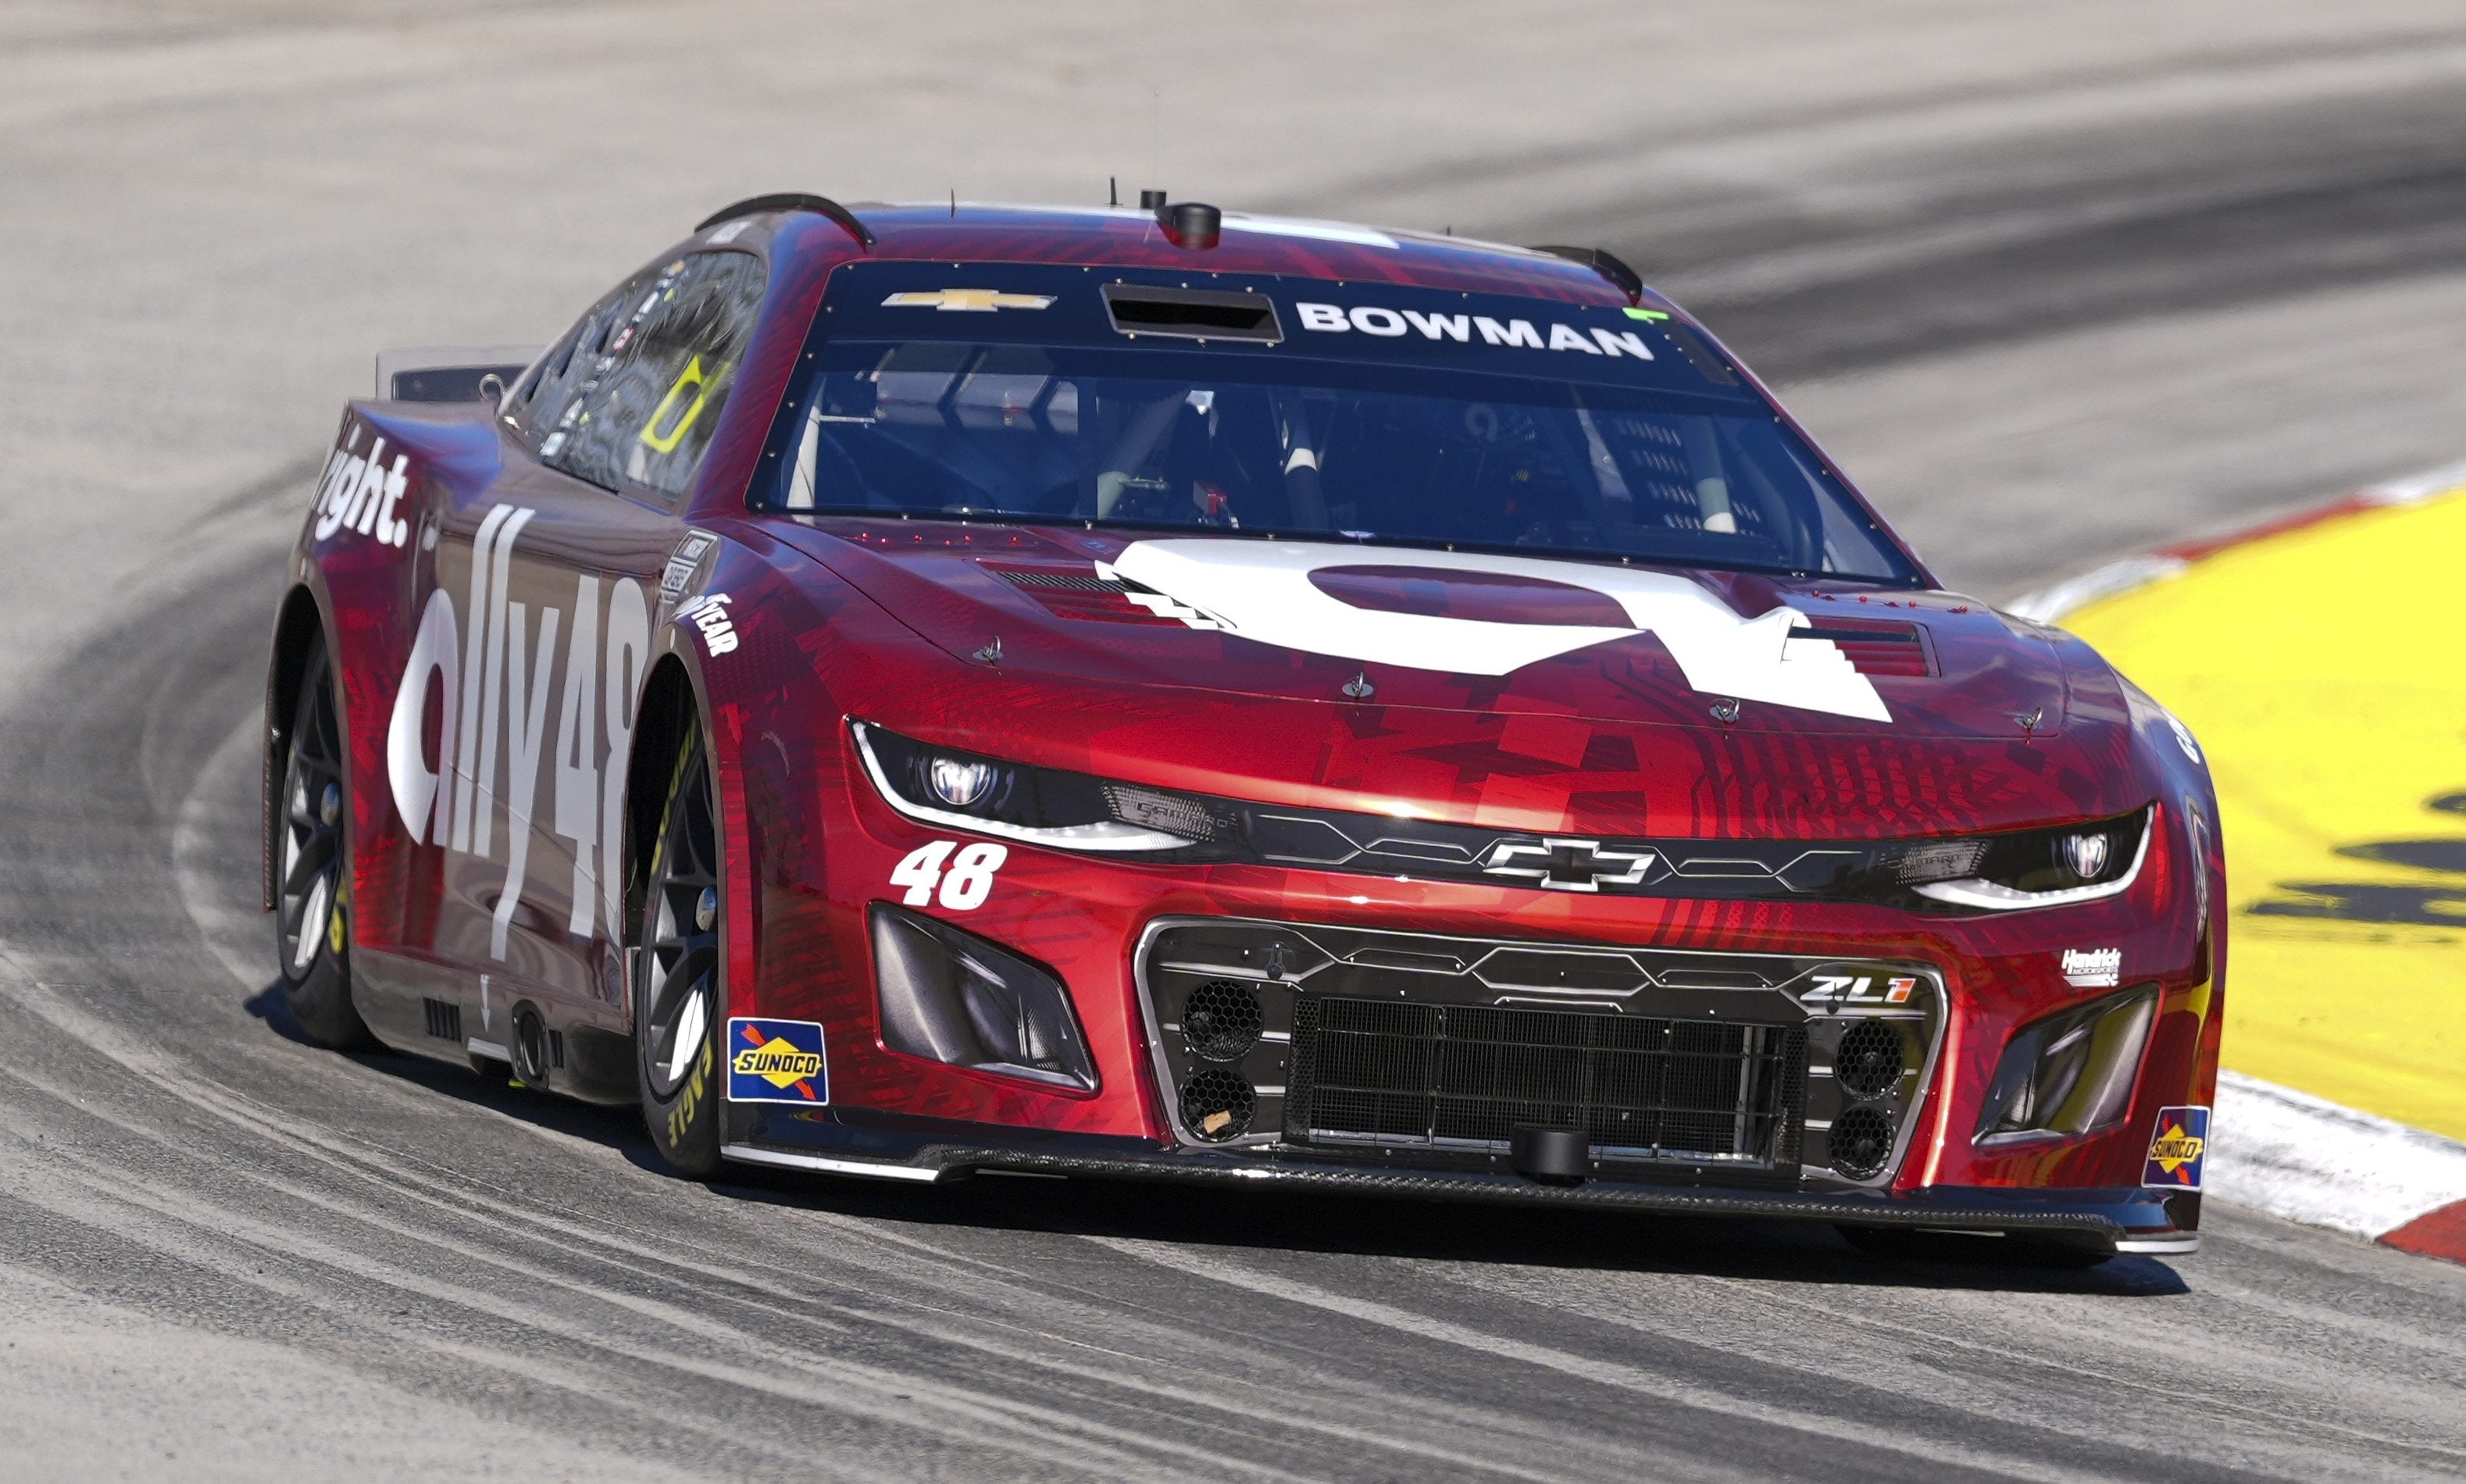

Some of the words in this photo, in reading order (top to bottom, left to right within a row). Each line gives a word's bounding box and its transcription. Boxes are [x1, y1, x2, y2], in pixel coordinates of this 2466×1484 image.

[1296, 302, 1654, 361] BOWMAN
[889, 840, 1008, 911] 48
[2061, 947, 2122, 976] Hendrick
[1799, 976, 1917, 1004] ZL1
[738, 1053, 818, 1074] SUNOCO
[2152, 1140, 2198, 1158] SUNOCO
